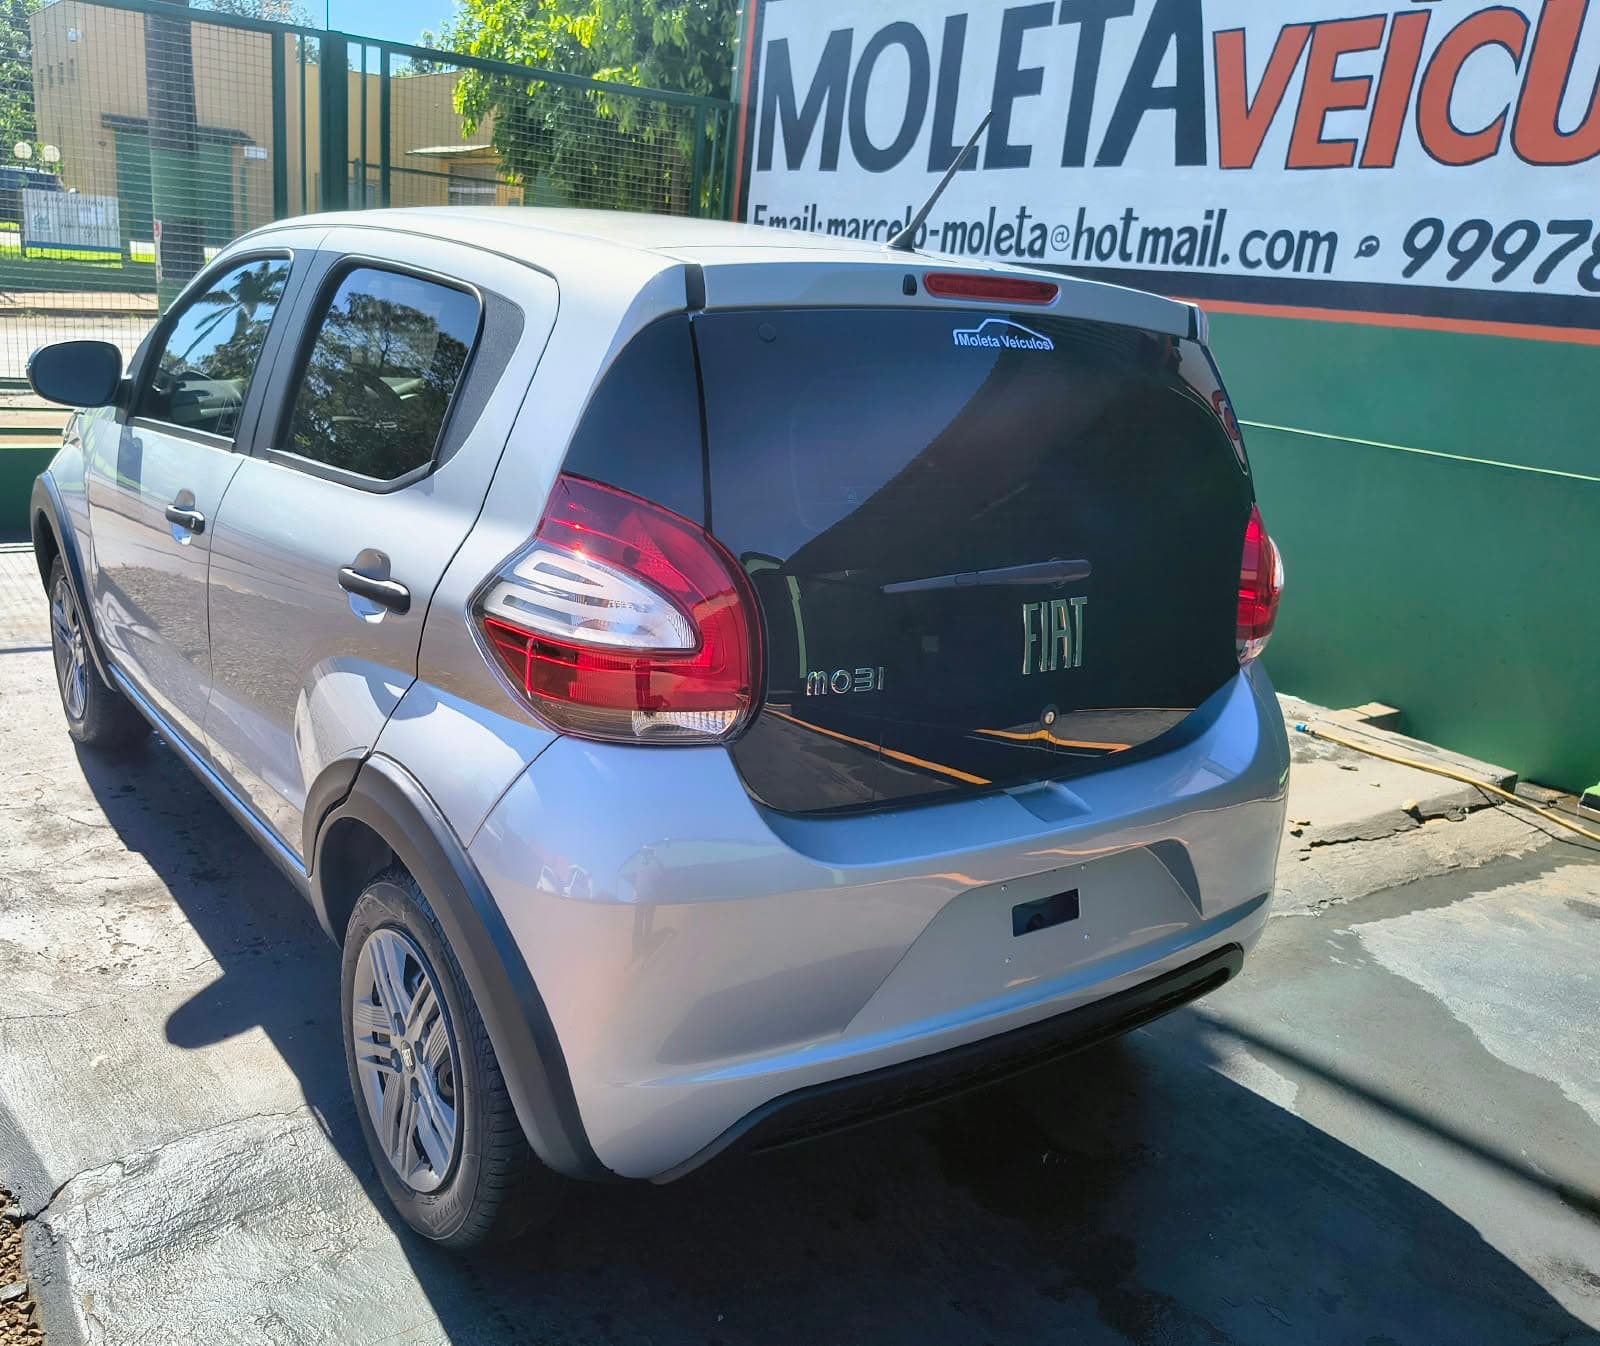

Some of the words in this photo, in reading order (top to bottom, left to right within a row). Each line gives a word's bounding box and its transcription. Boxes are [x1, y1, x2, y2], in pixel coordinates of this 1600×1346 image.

[757, 0, 1207, 173] MOLETA
[958, 334, 1000, 347] Moleta
[1022, 597, 1087, 674] FIAT
